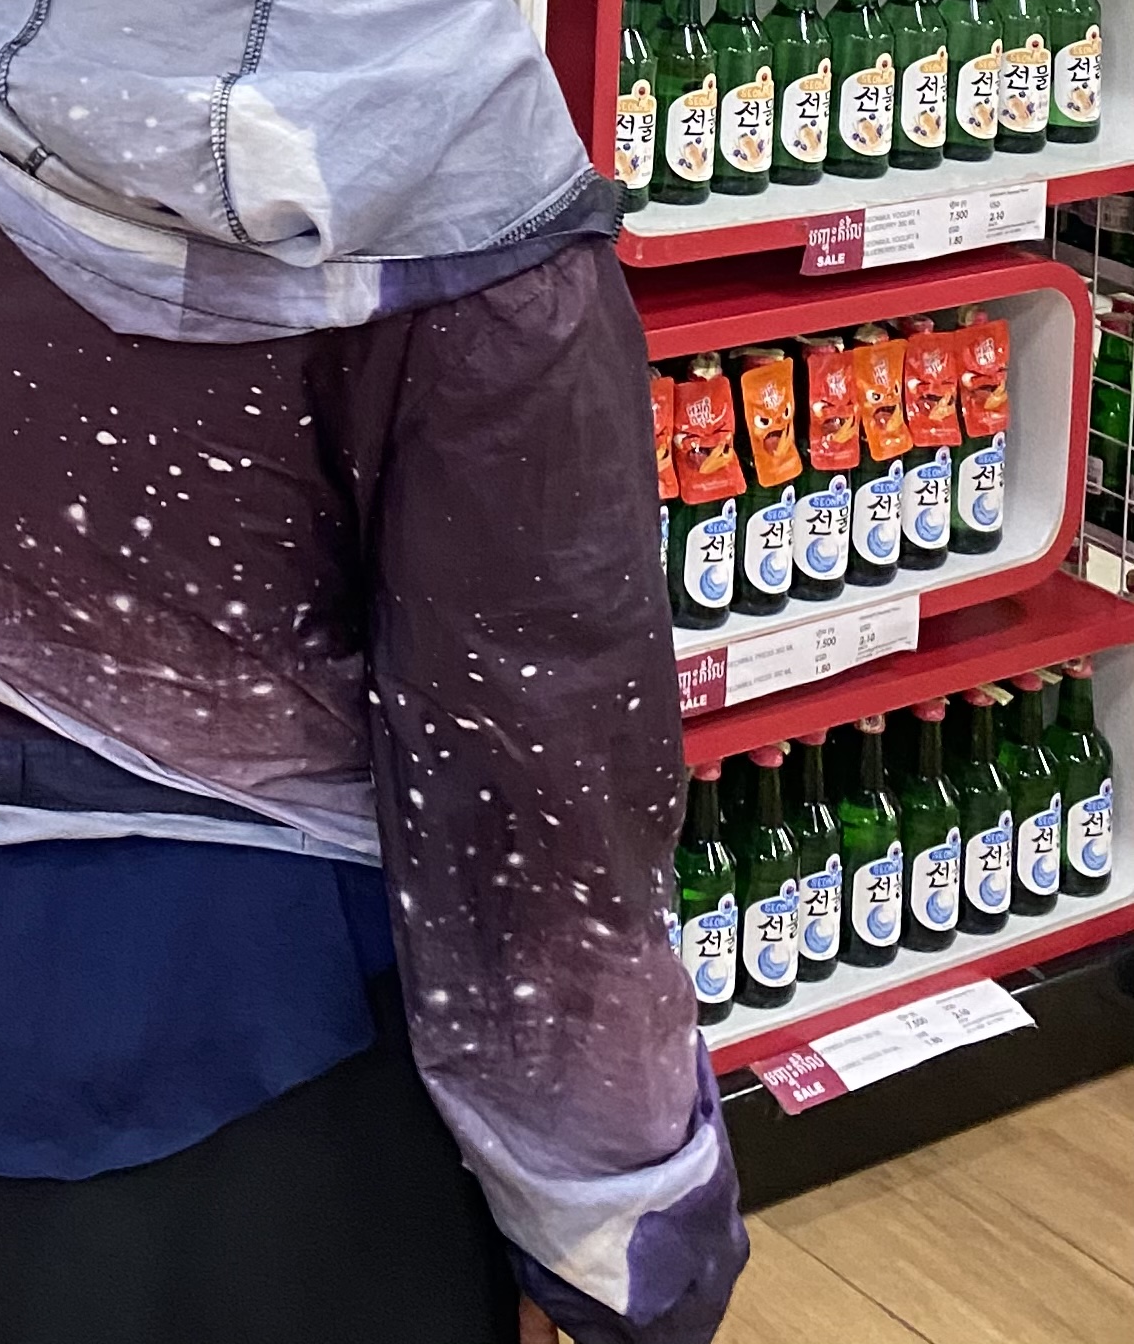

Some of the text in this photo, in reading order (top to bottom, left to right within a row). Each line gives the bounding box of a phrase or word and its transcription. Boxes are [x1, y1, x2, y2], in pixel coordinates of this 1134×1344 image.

[949, 236, 963, 246] 1.80
[817, 252, 845, 267] SALE
[792, 1081, 826, 1103] SALE
